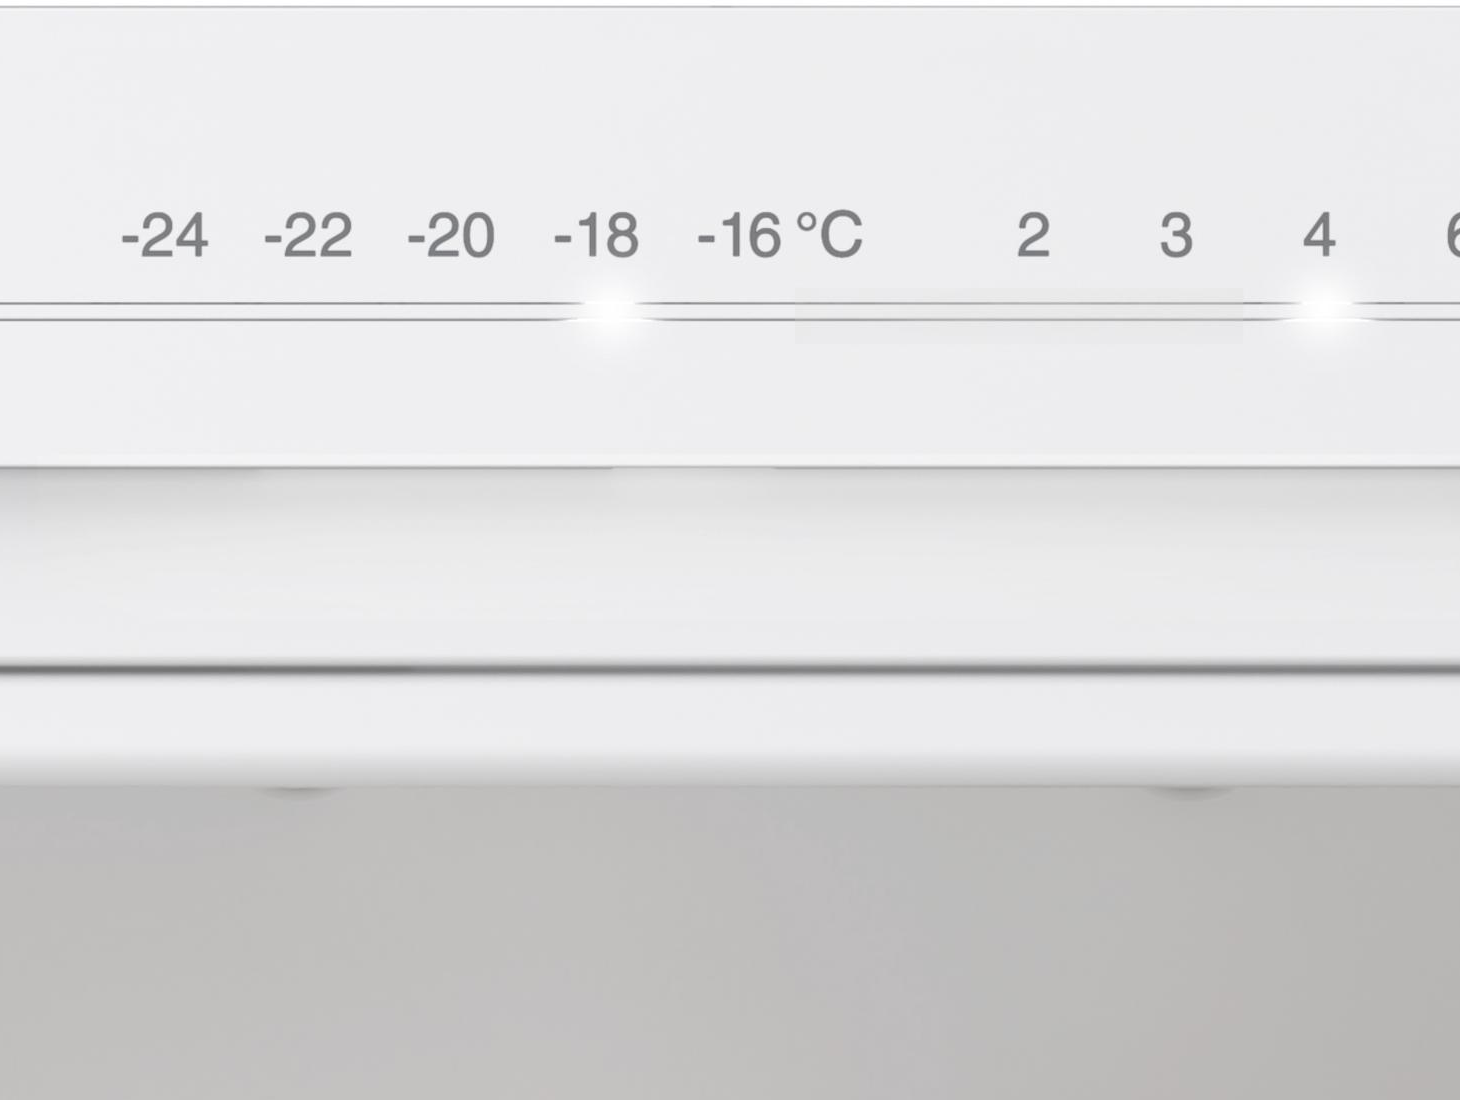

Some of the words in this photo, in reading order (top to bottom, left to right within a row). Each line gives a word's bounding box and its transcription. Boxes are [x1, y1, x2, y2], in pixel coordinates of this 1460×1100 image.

[121, 211, 209, 258] -24
[264, 211, 352, 258] -22
[407, 211, 495, 259] -20
[554, 211, 639, 259] -18
[697, 211, 782, 259] -16
[796, 208, 863, 259] °C
[1017, 211, 1050, 258] 2
[1160, 211, 1193, 259] 3
[1303, 211, 1337, 257] 4
